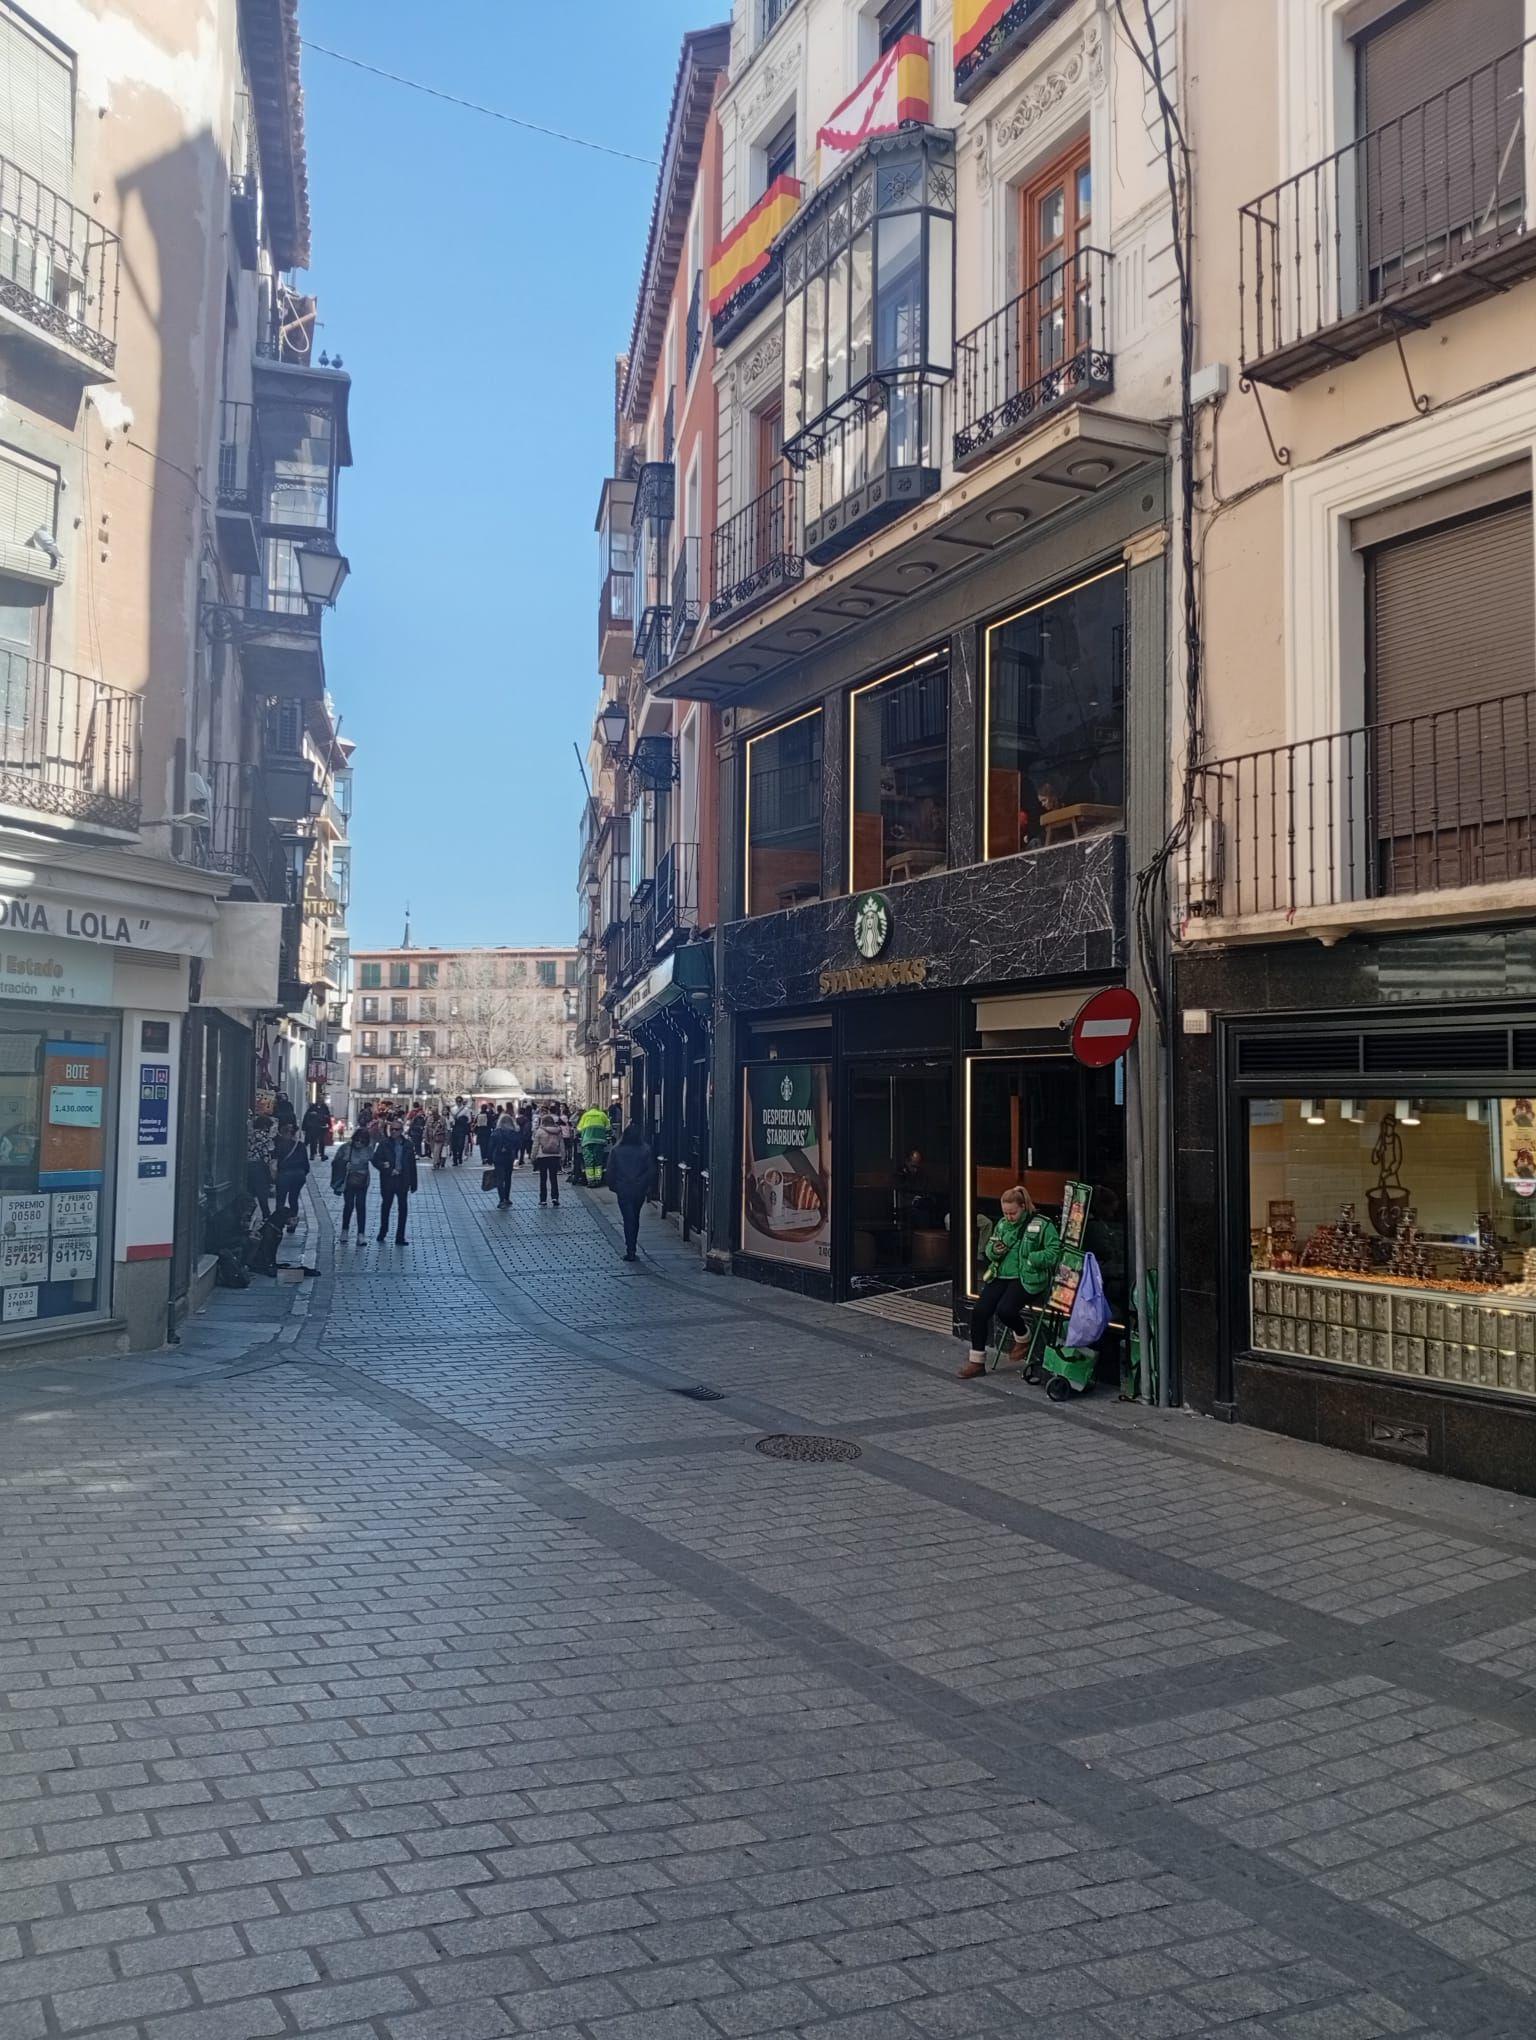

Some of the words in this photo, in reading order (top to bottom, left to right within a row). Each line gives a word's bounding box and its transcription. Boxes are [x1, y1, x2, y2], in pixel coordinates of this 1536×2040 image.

[66, 908, 131, 943] LOLA
[7, 955, 64, 978] Estado
[818, 958, 927, 994] STARBUCKS
[0, 982, 38, 996] tración
[70, 987, 75, 998] 1
[66, 1064, 90, 1079] BOTE
[762, 1109, 797, 1125] DESPIERTA
[797, 1109, 812, 1126] CON
[57, 1202, 93, 1213] 20140
[11, 1210, 41, 1221] 00580
[4, 1252, 43, 1266] 57421
[55, 1249, 93, 1263] 91179
